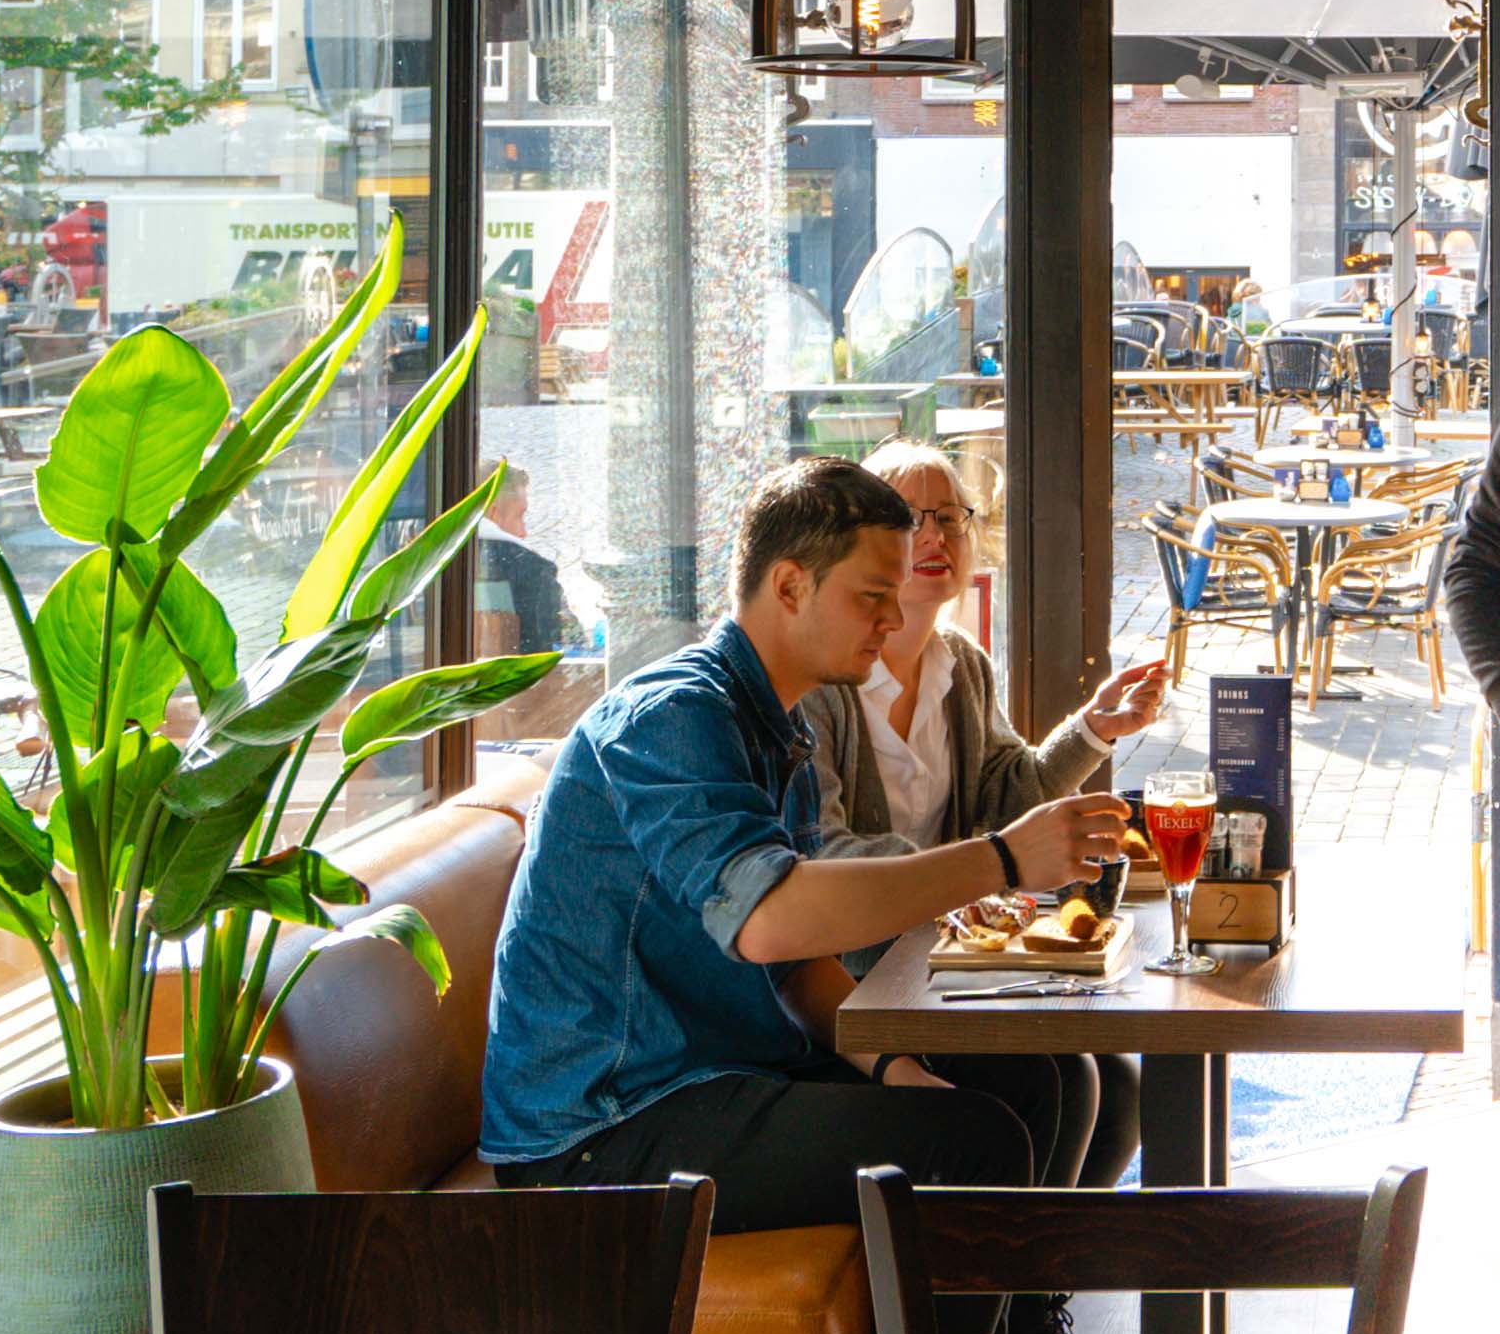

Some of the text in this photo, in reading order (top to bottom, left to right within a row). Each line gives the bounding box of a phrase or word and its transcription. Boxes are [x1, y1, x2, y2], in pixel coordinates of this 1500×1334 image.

[1217, 689, 1249, 700] DRINKS
[1155, 812, 1203, 829] TEXELS
[1217, 893, 1243, 930] 2
